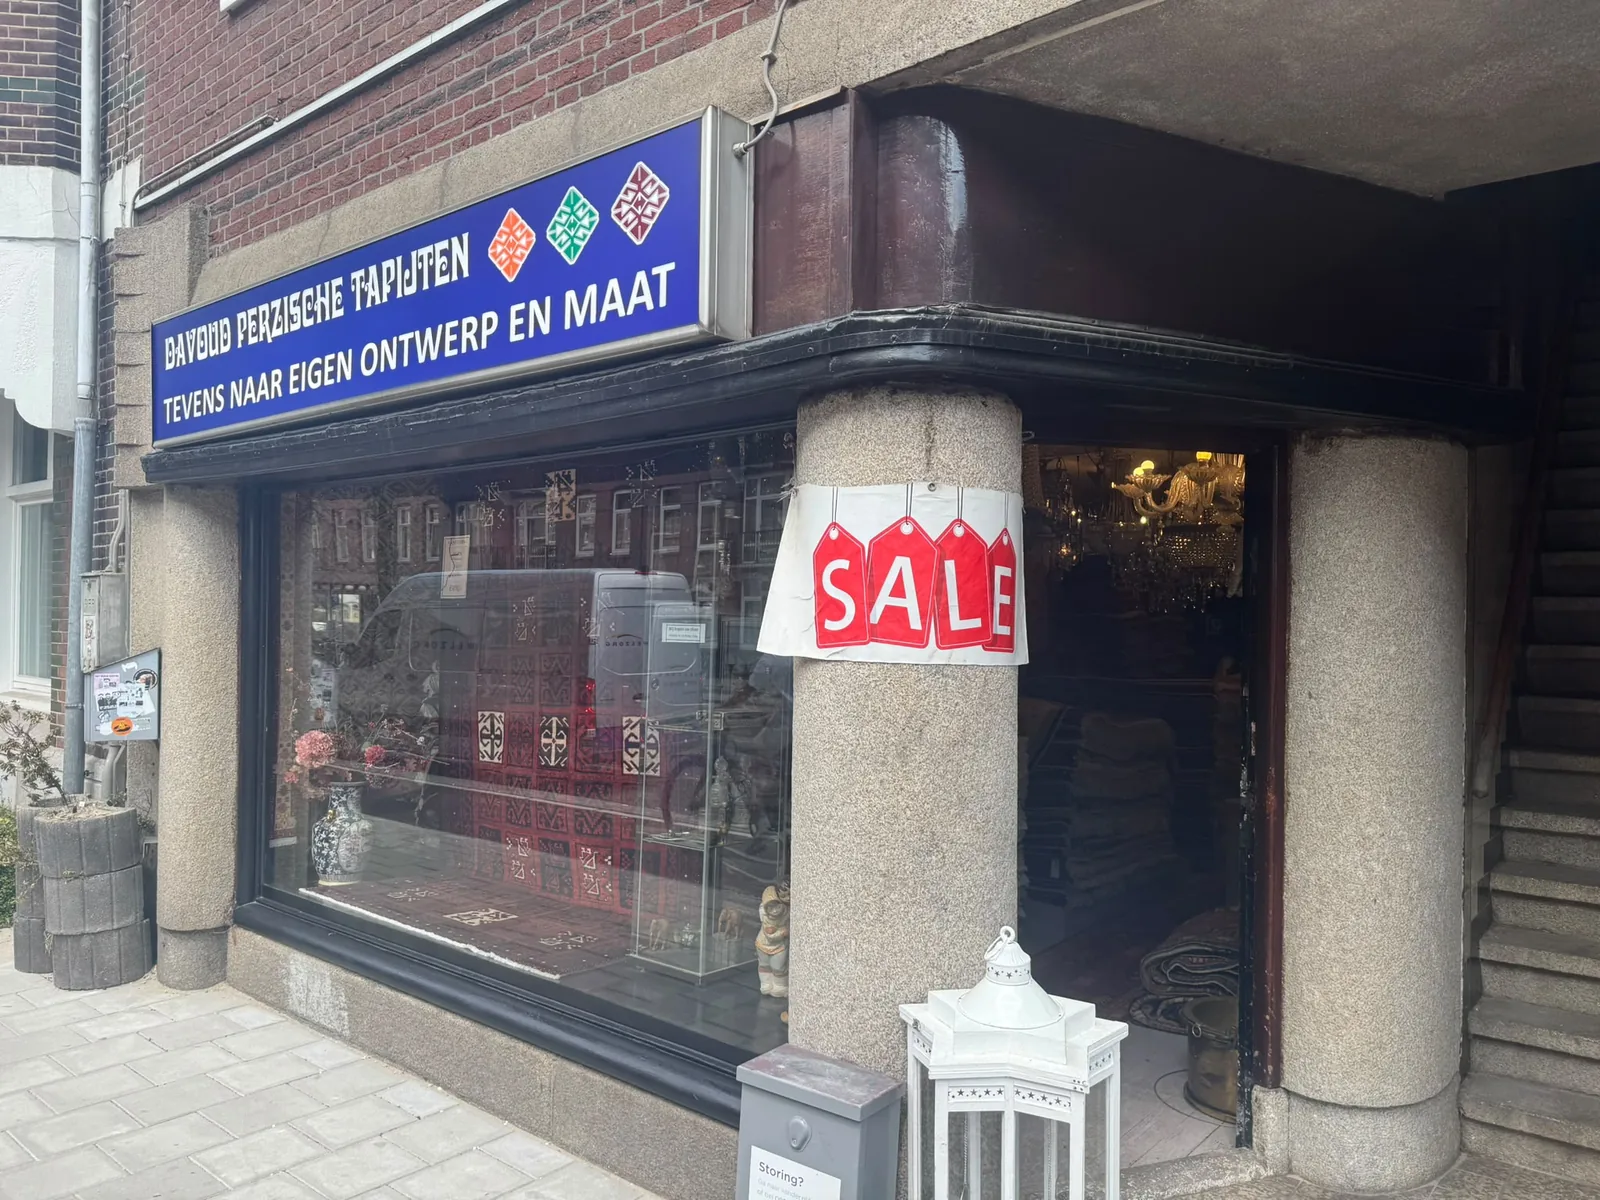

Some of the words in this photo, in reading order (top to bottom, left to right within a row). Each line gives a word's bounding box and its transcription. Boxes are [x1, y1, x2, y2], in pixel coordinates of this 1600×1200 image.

[163, 383, 225, 425] TEVENS
[230, 368, 283, 409] NAAR
[289, 348, 353, 395] EIGEN
[360, 310, 499, 377] ONTWERP
[509, 295, 551, 343] EN
[564, 261, 676, 330] MAAT
[164, 317, 232, 371] DAVOUD
[236, 276, 345, 349] PERZISCHE
[350, 231, 470, 312] TAPIJTEN
[821, 555, 1012, 636] SALE
[758, 1161, 804, 1187] Storing?
